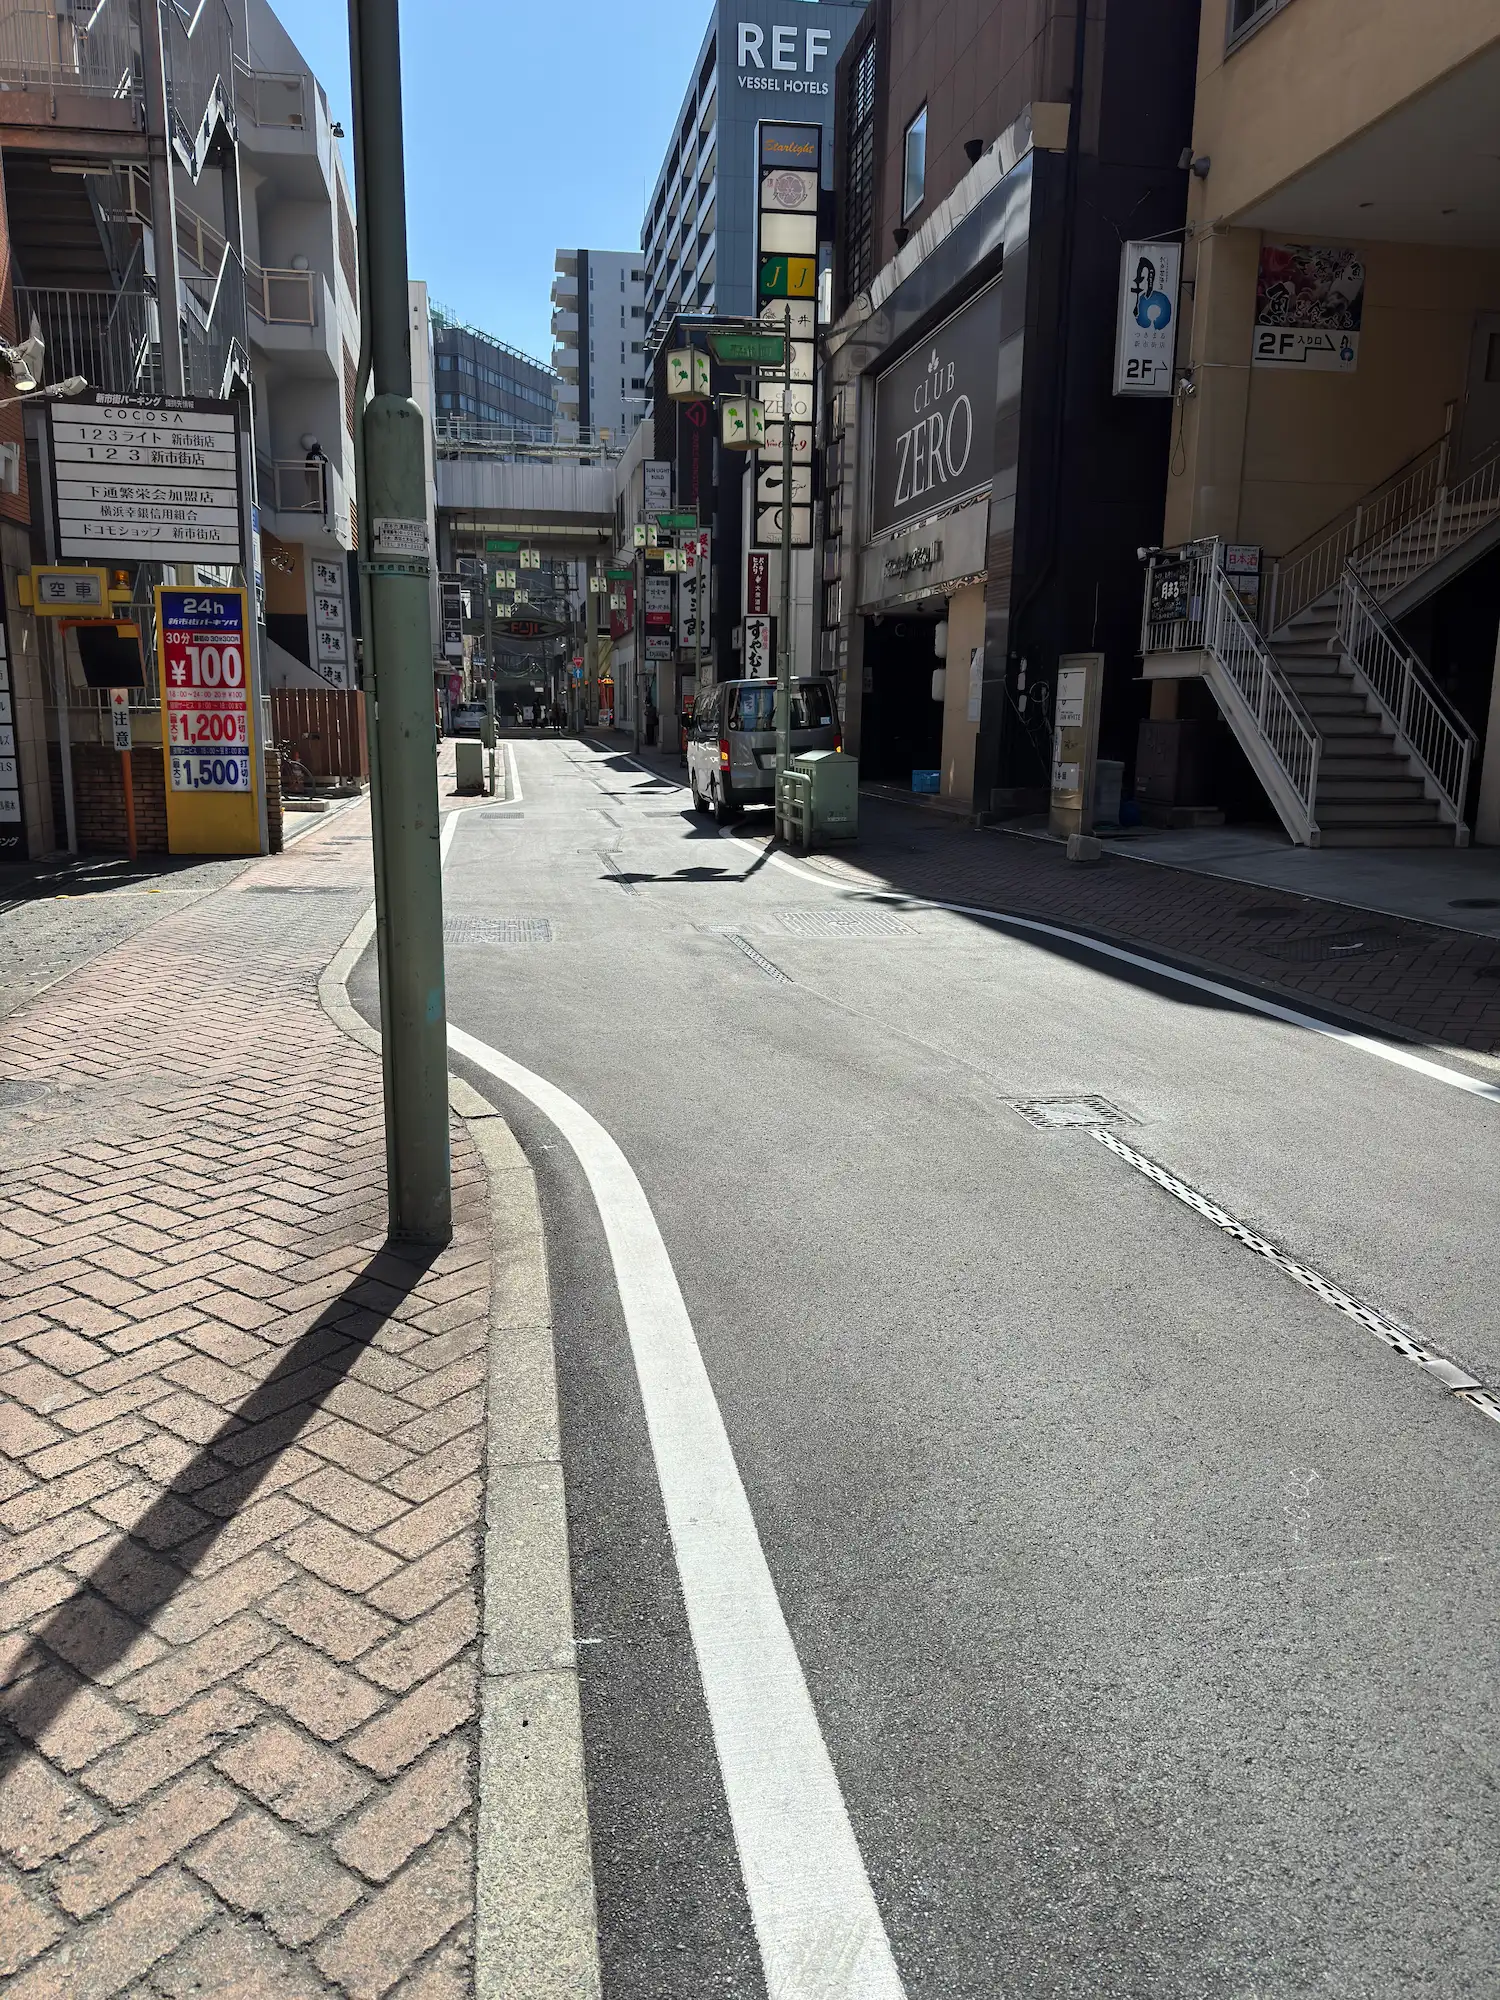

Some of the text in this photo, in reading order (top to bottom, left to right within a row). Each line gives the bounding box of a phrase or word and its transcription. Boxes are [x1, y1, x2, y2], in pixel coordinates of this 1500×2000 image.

[737, 21, 831, 72] REF
[738, 75, 829, 95] VESSEL HOTELS
[764, 138, 815, 157] Starlight
[1259, 332, 1322, 355] 2F 入り口
[1127, 358, 1153, 379] 2F
[914, 361, 956, 413] CLUB
[95, 393, 163, 407] 新市街パーキング
[104, 408, 184, 423] COCOSA
[171, 433, 215, 448] 新市街店
[151, 450, 205, 466] 新市街店
[894, 394, 973, 508] ZERO
[85, 485, 215, 504] 下通繁栄会加盟店
[100, 505, 198, 522] 横浜幸銀信用組合
[83, 523, 221, 541] ドコモショップ 新市街店
[1229, 553, 1258, 567] 日本酒
[50, 581, 91, 598] 空車
[183, 598, 224, 615] 24h
[168, 617, 239, 627] 新市街パーキング
[165, 632, 191, 645] 30分
[170, 646, 243, 688] ¥100
[113, 711, 129, 747] 注意
[180, 713, 237, 744] 1,200
[237, 715, 246, 743] 打切り
[183, 759, 239, 789] 1,500
[240, 759, 249, 787] 打切り
